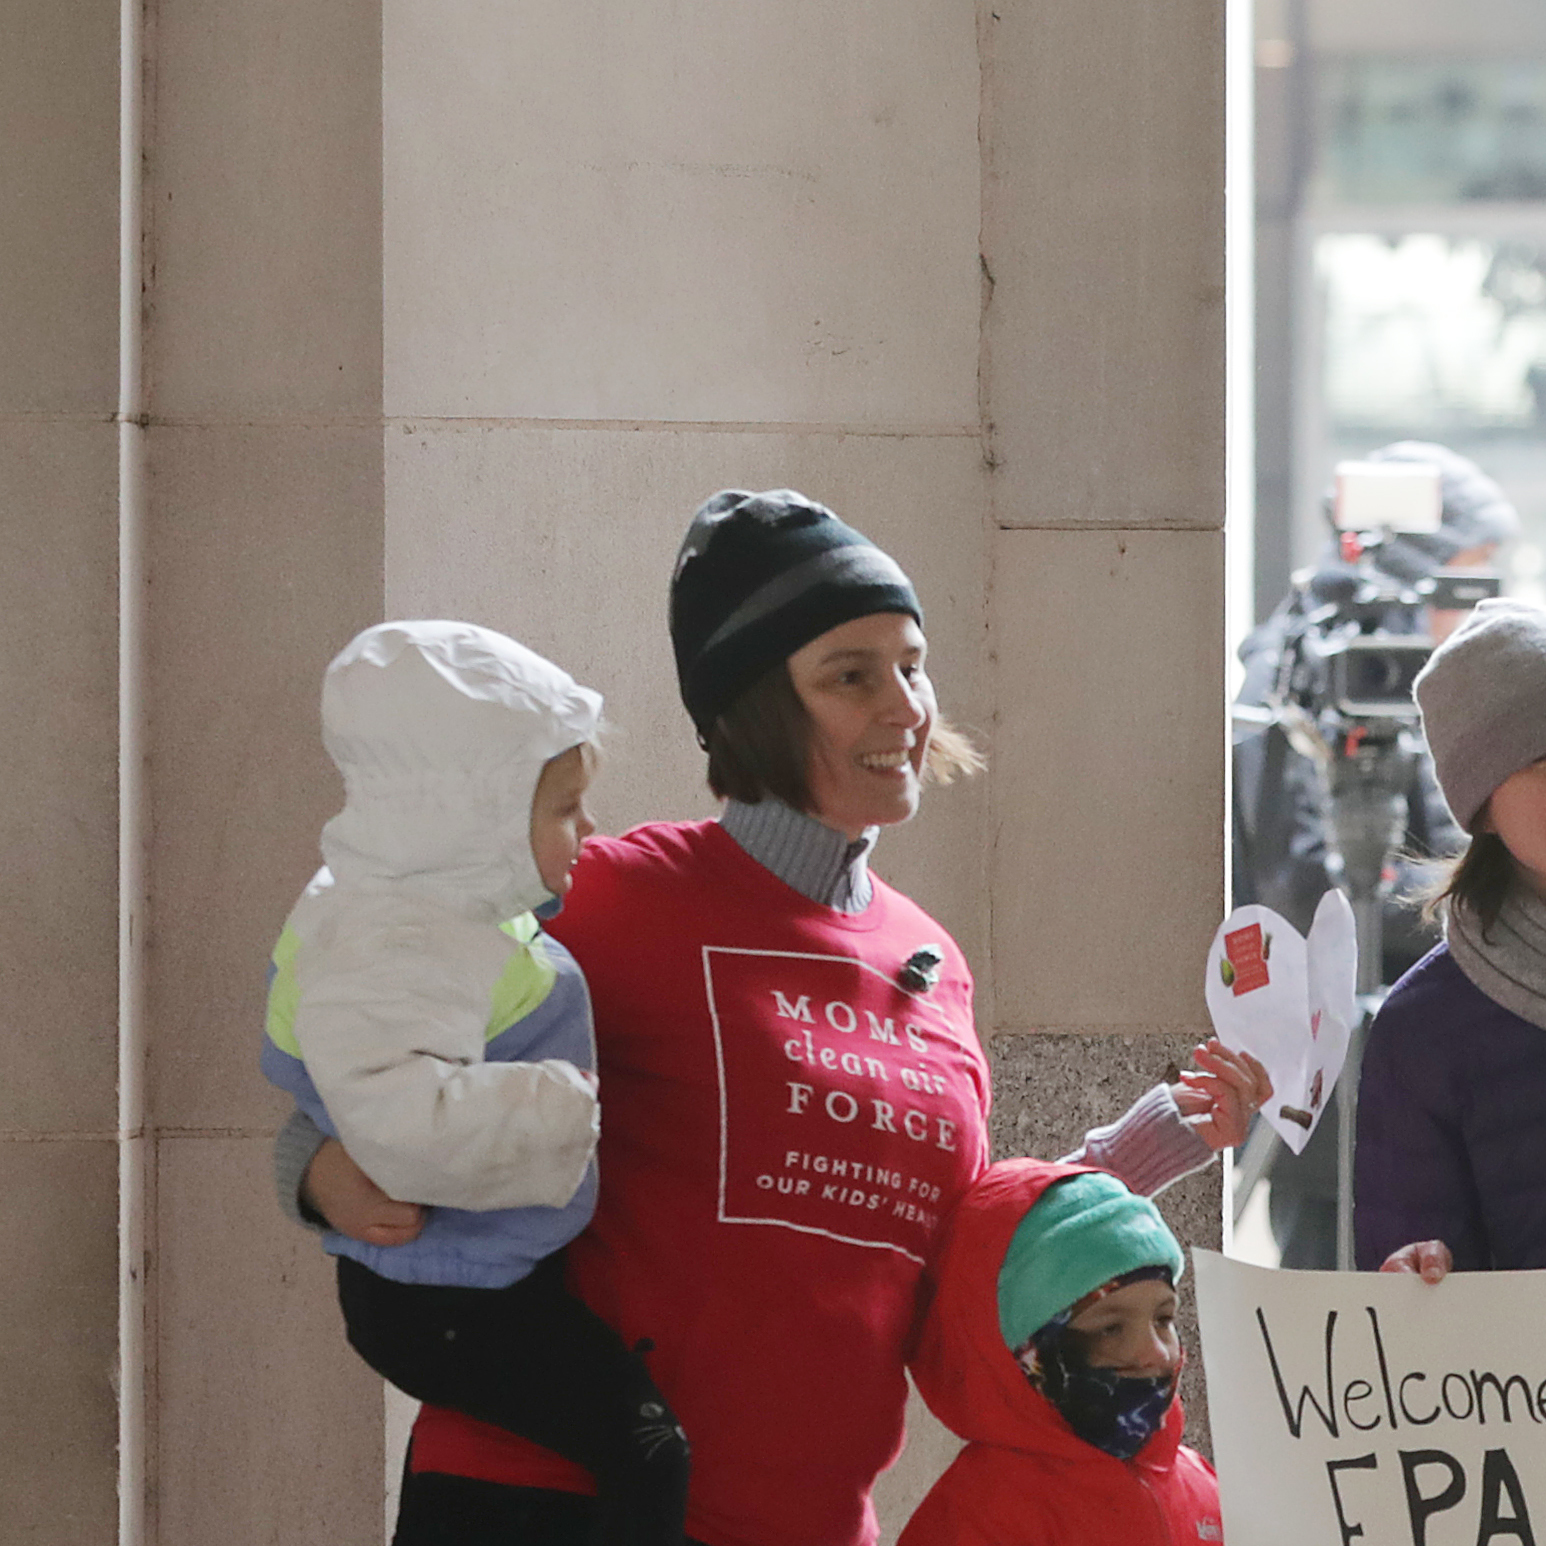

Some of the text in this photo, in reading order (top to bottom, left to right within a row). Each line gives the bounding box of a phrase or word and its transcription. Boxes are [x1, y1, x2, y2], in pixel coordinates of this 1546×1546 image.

[771, 990, 929, 1054] MOMS
[783, 1031, 948, 1097] clean air
[786, 1081, 958, 1153] FORCE
[756, 1174, 810, 1196] OUR
[821, 1183, 888, 1212] KIDS'
[785, 1150, 942, 1202] FIGHTING FOR
